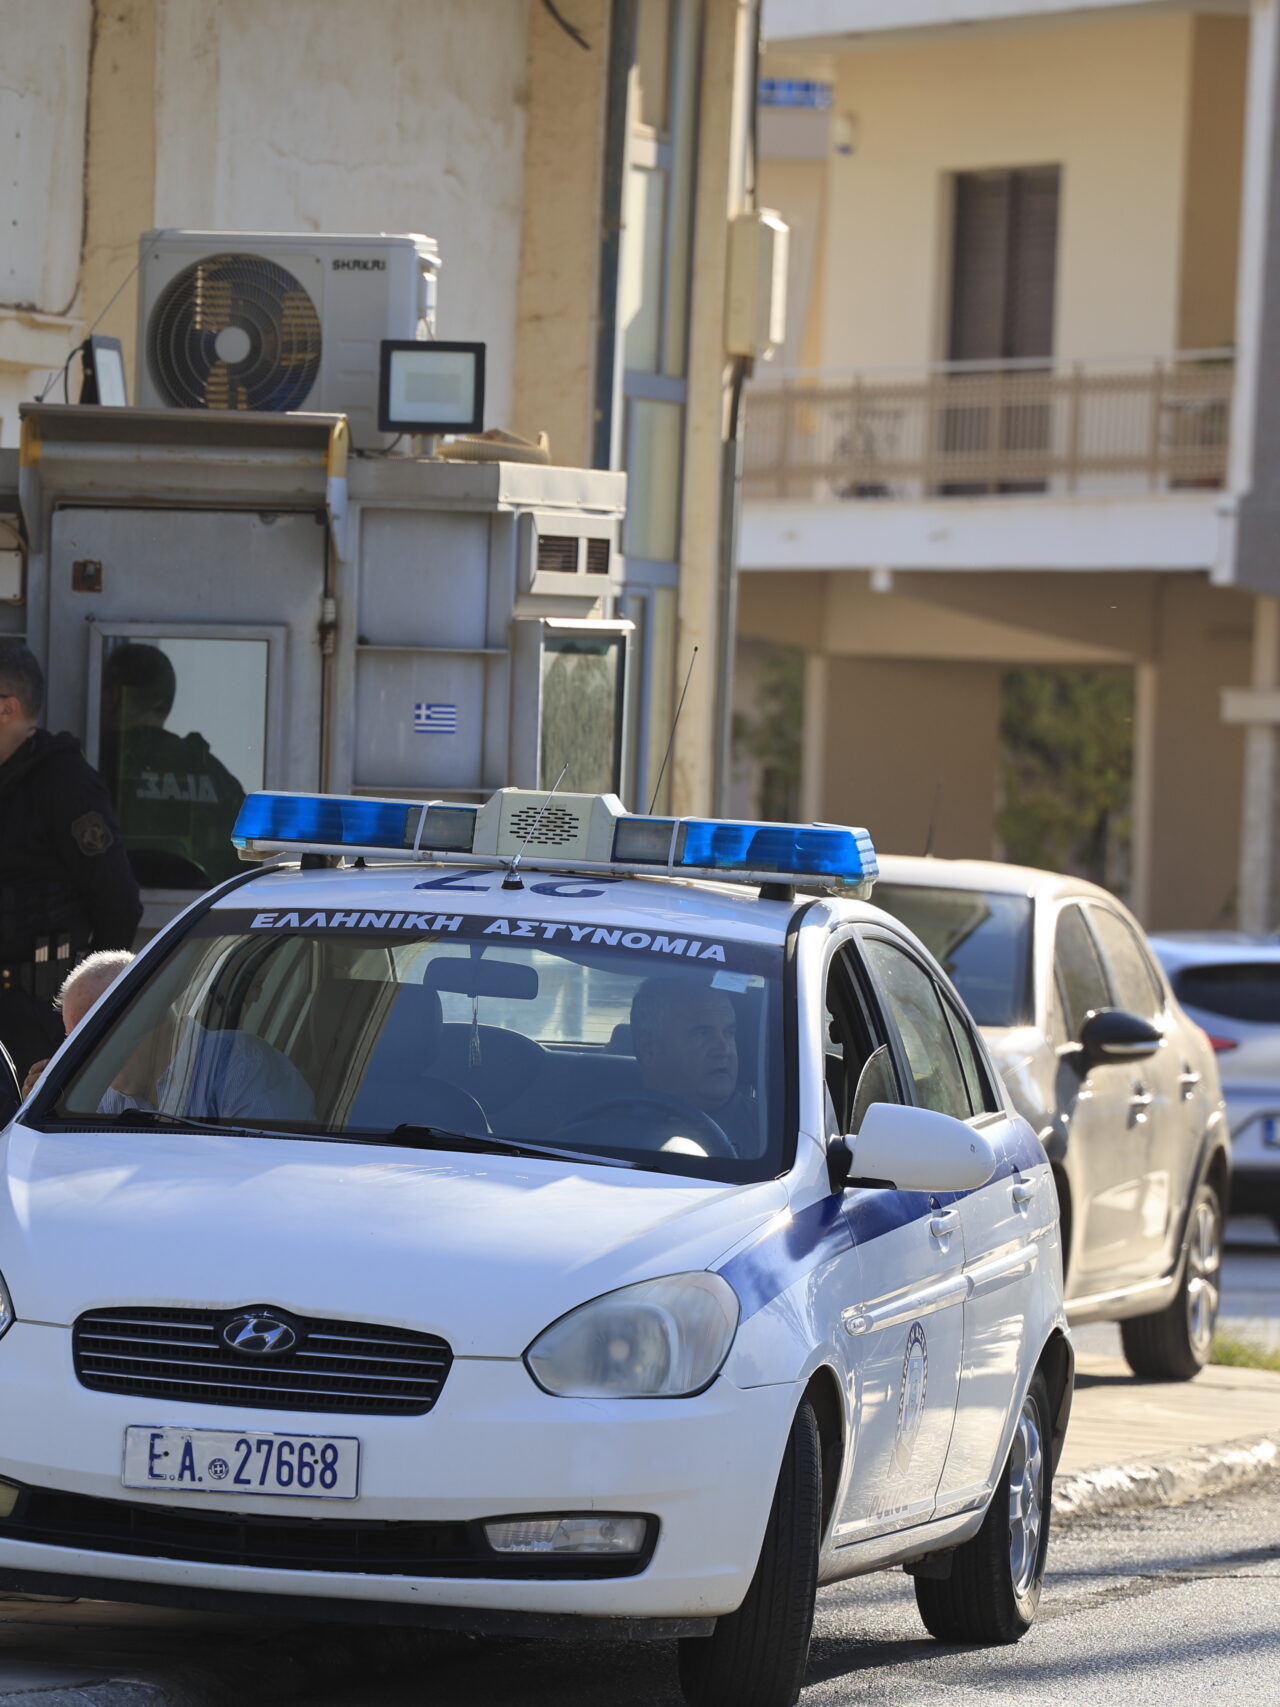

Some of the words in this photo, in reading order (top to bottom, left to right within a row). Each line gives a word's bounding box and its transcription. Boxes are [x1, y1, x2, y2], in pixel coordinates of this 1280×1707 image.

[413, 869, 624, 898] 27
[250, 911, 464, 932] ΕΛΛΗΝΙΚΗ
[482, 918, 727, 963] ΑΣΤΥΝΟΜΙΑ
[233, 1438, 339, 1490] 27668
